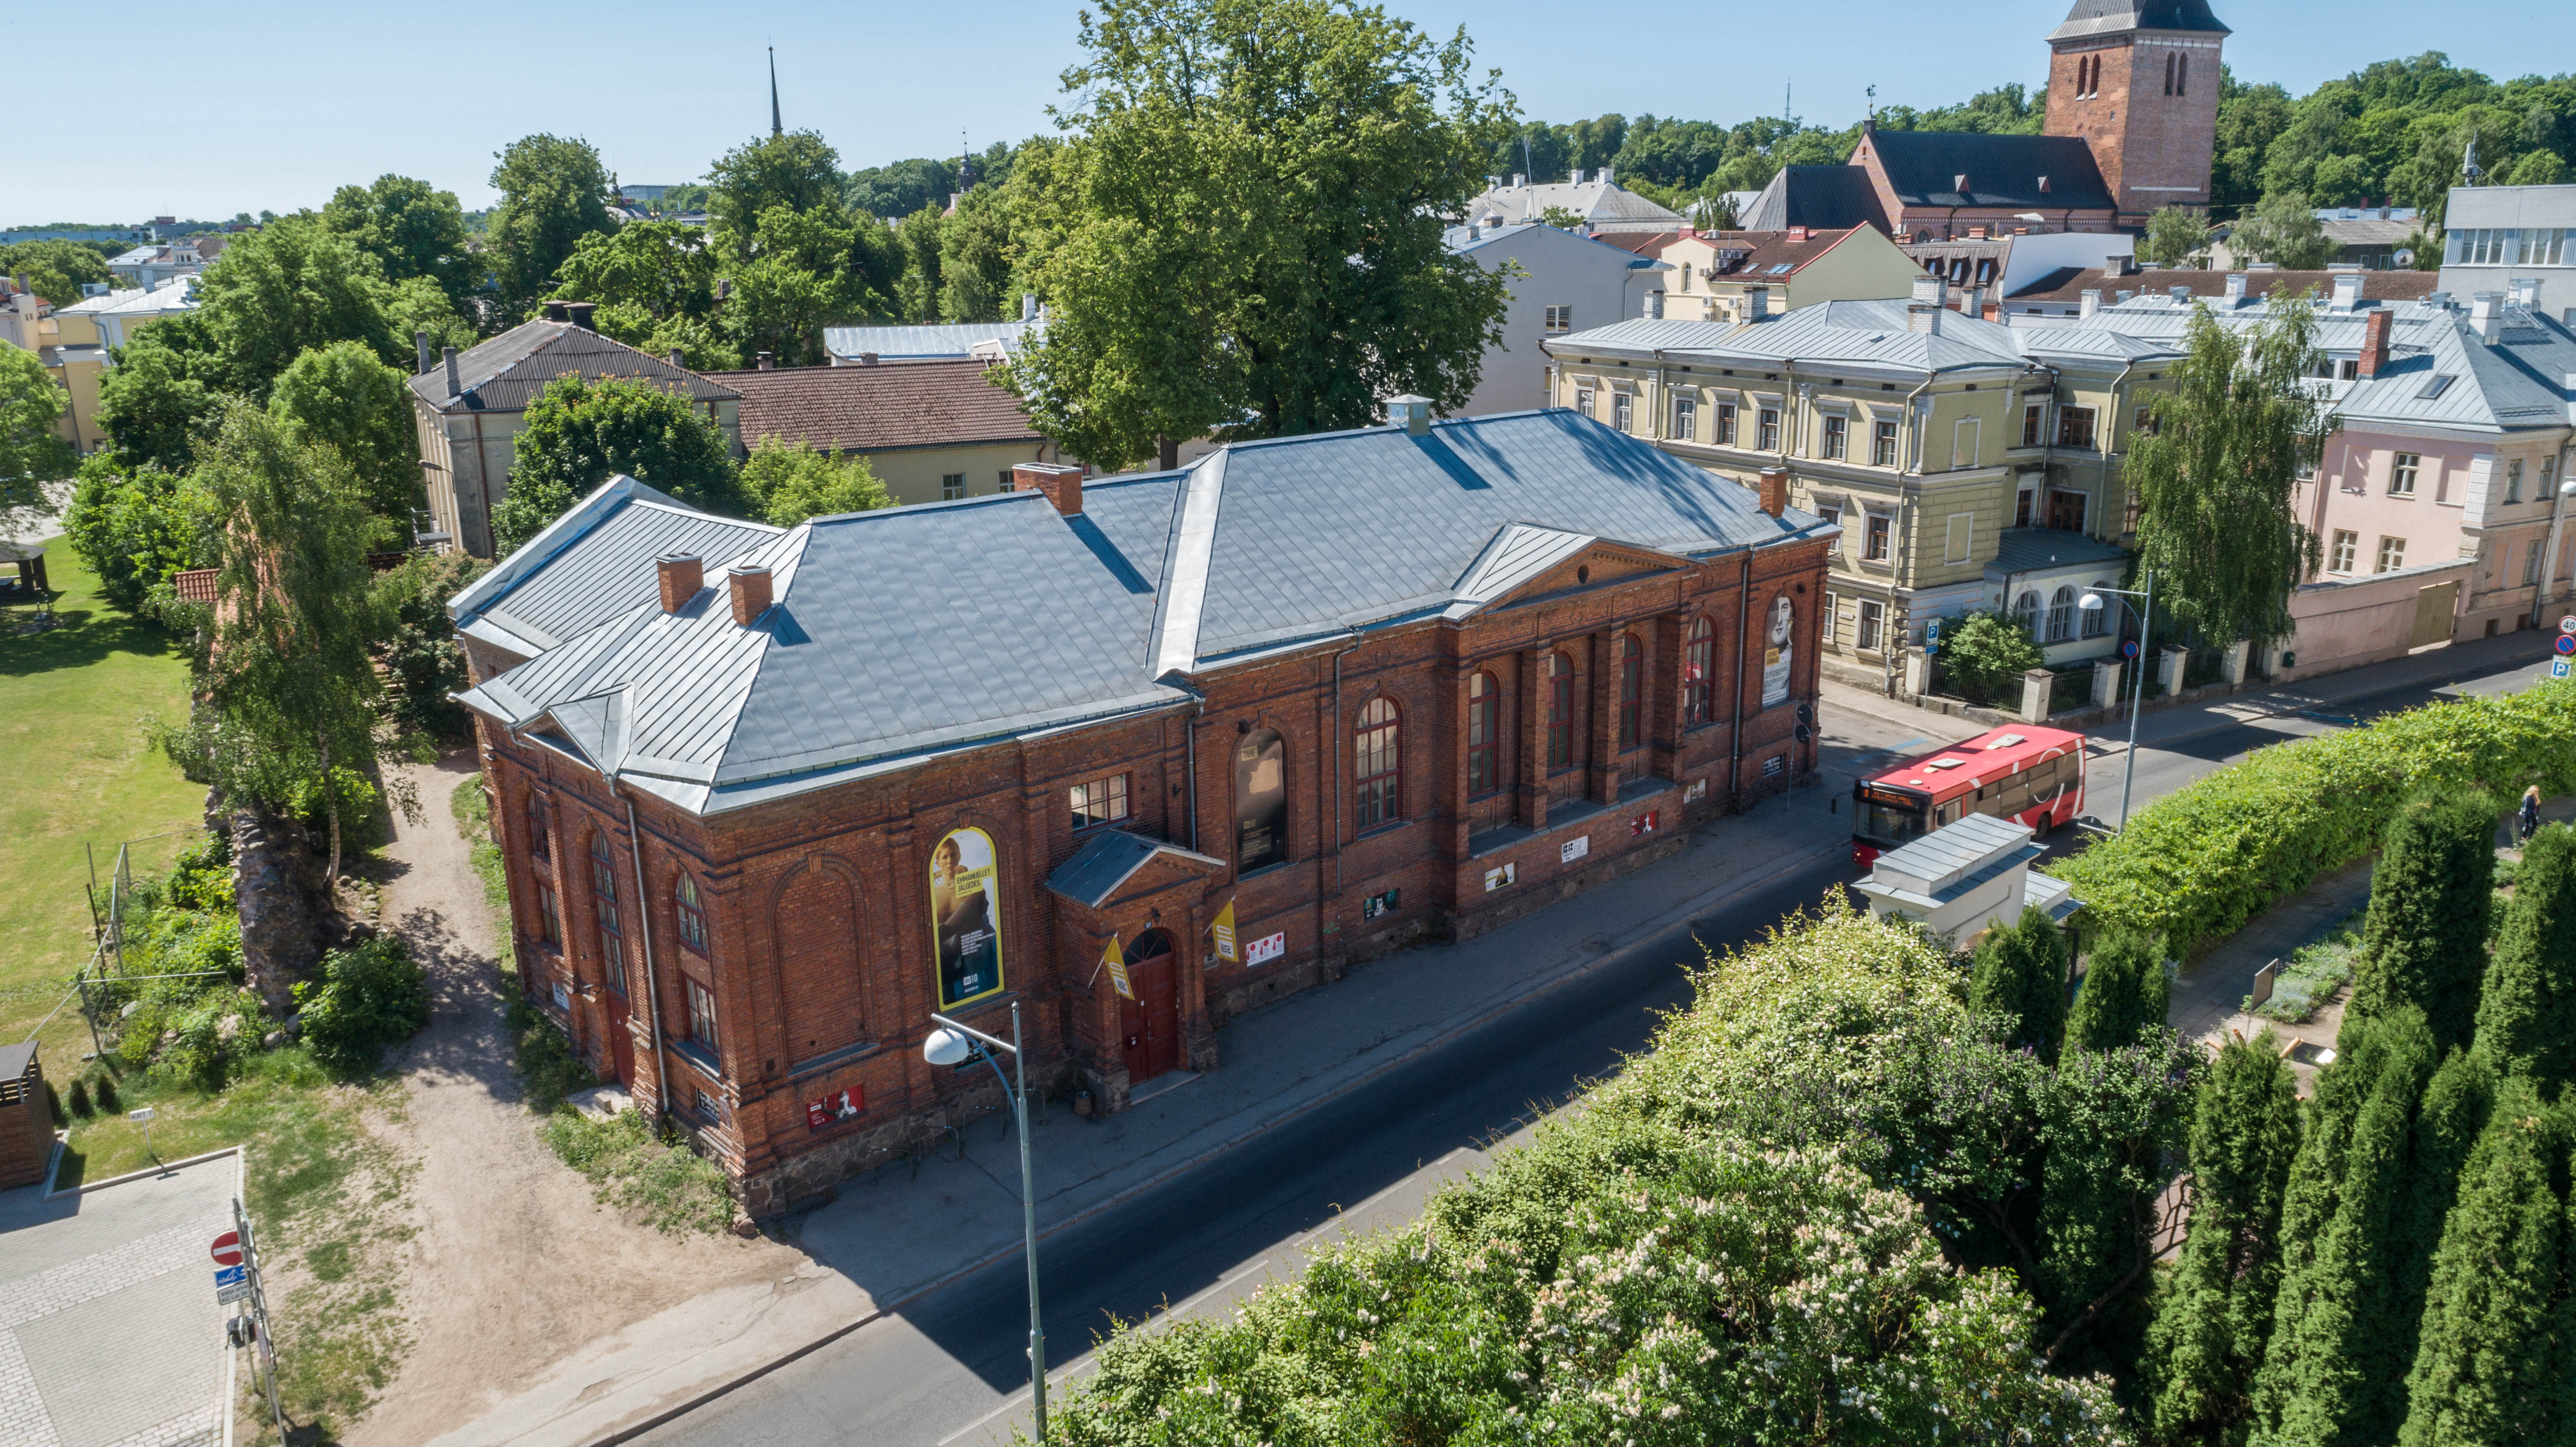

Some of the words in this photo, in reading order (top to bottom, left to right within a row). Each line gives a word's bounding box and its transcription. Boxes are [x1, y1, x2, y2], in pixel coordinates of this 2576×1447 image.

[2563, 621, 2575, 630] 40
[1930, 627, 1936, 637] P
[2555, 663, 2565, 674] P
[132, 1111, 146, 1120] KRT
